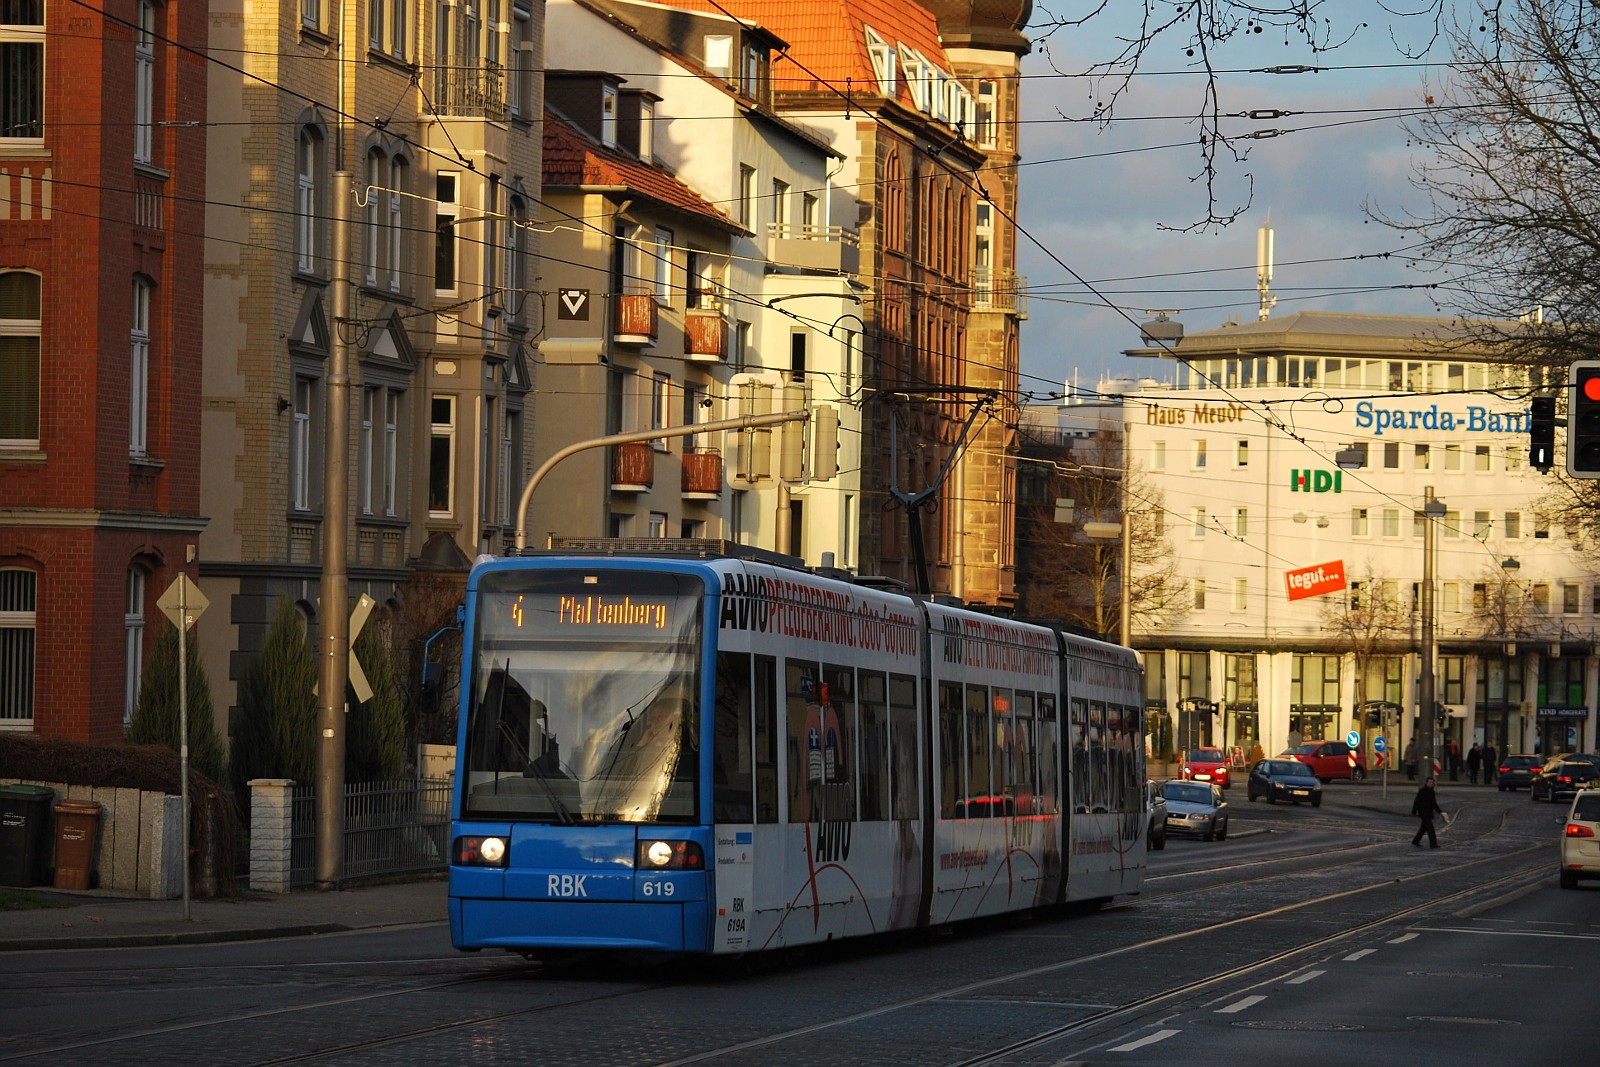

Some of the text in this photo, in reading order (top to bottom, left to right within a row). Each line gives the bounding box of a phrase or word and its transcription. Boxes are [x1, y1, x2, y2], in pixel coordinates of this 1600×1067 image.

[1147, 402, 1248, 425] Haus Meudt
[1290, 469, 1342, 493] HDI
[1288, 567, 1340, 589] tegut...
[512, 594, 524, 627] 4
[547, 874, 587, 897] RBK
[642, 881, 675, 897] 619
[732, 897, 745, 912] RBK
[727, 918, 746, 932] 619A
